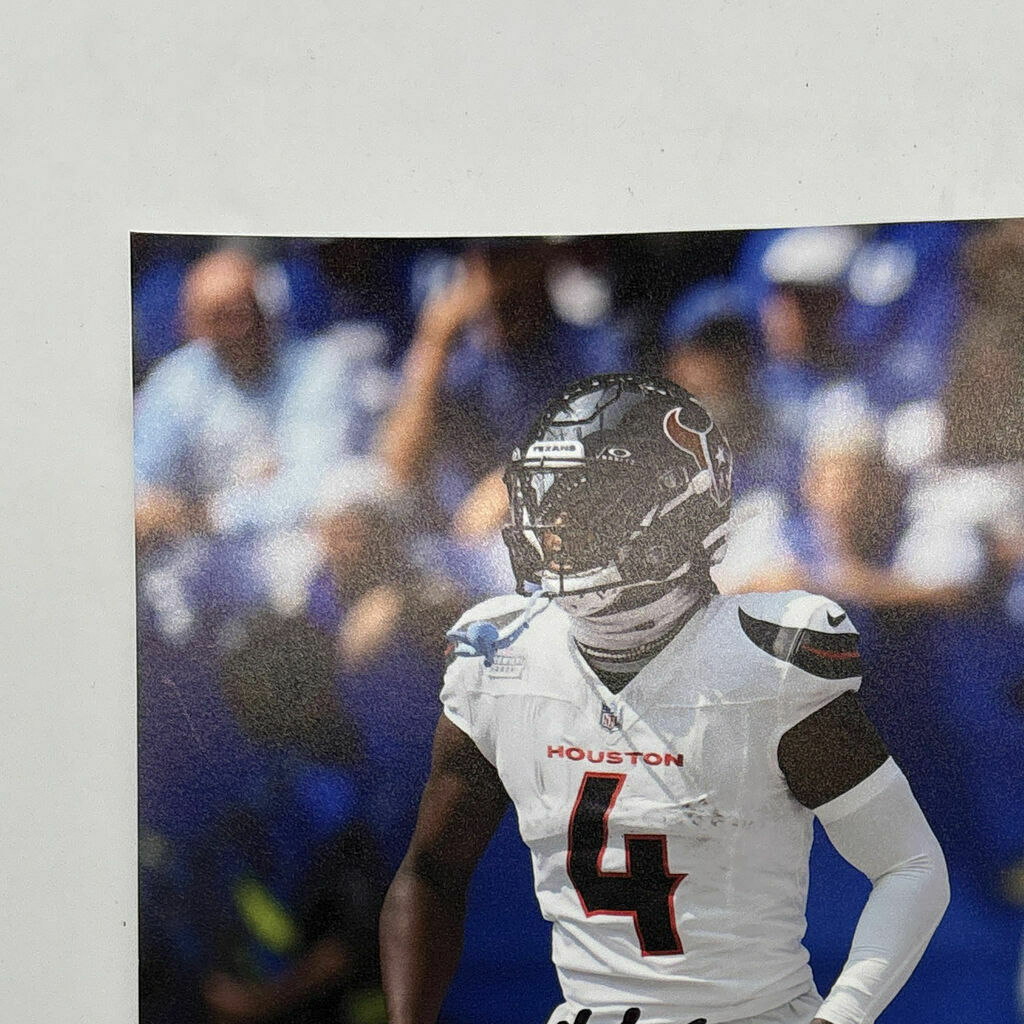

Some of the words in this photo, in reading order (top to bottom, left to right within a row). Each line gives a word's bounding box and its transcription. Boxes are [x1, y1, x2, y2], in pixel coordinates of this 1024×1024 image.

[532, 444, 577, 452] TEXANS
[546, 745, 684, 767] HOUSTON
[567, 772, 688, 957] 4
